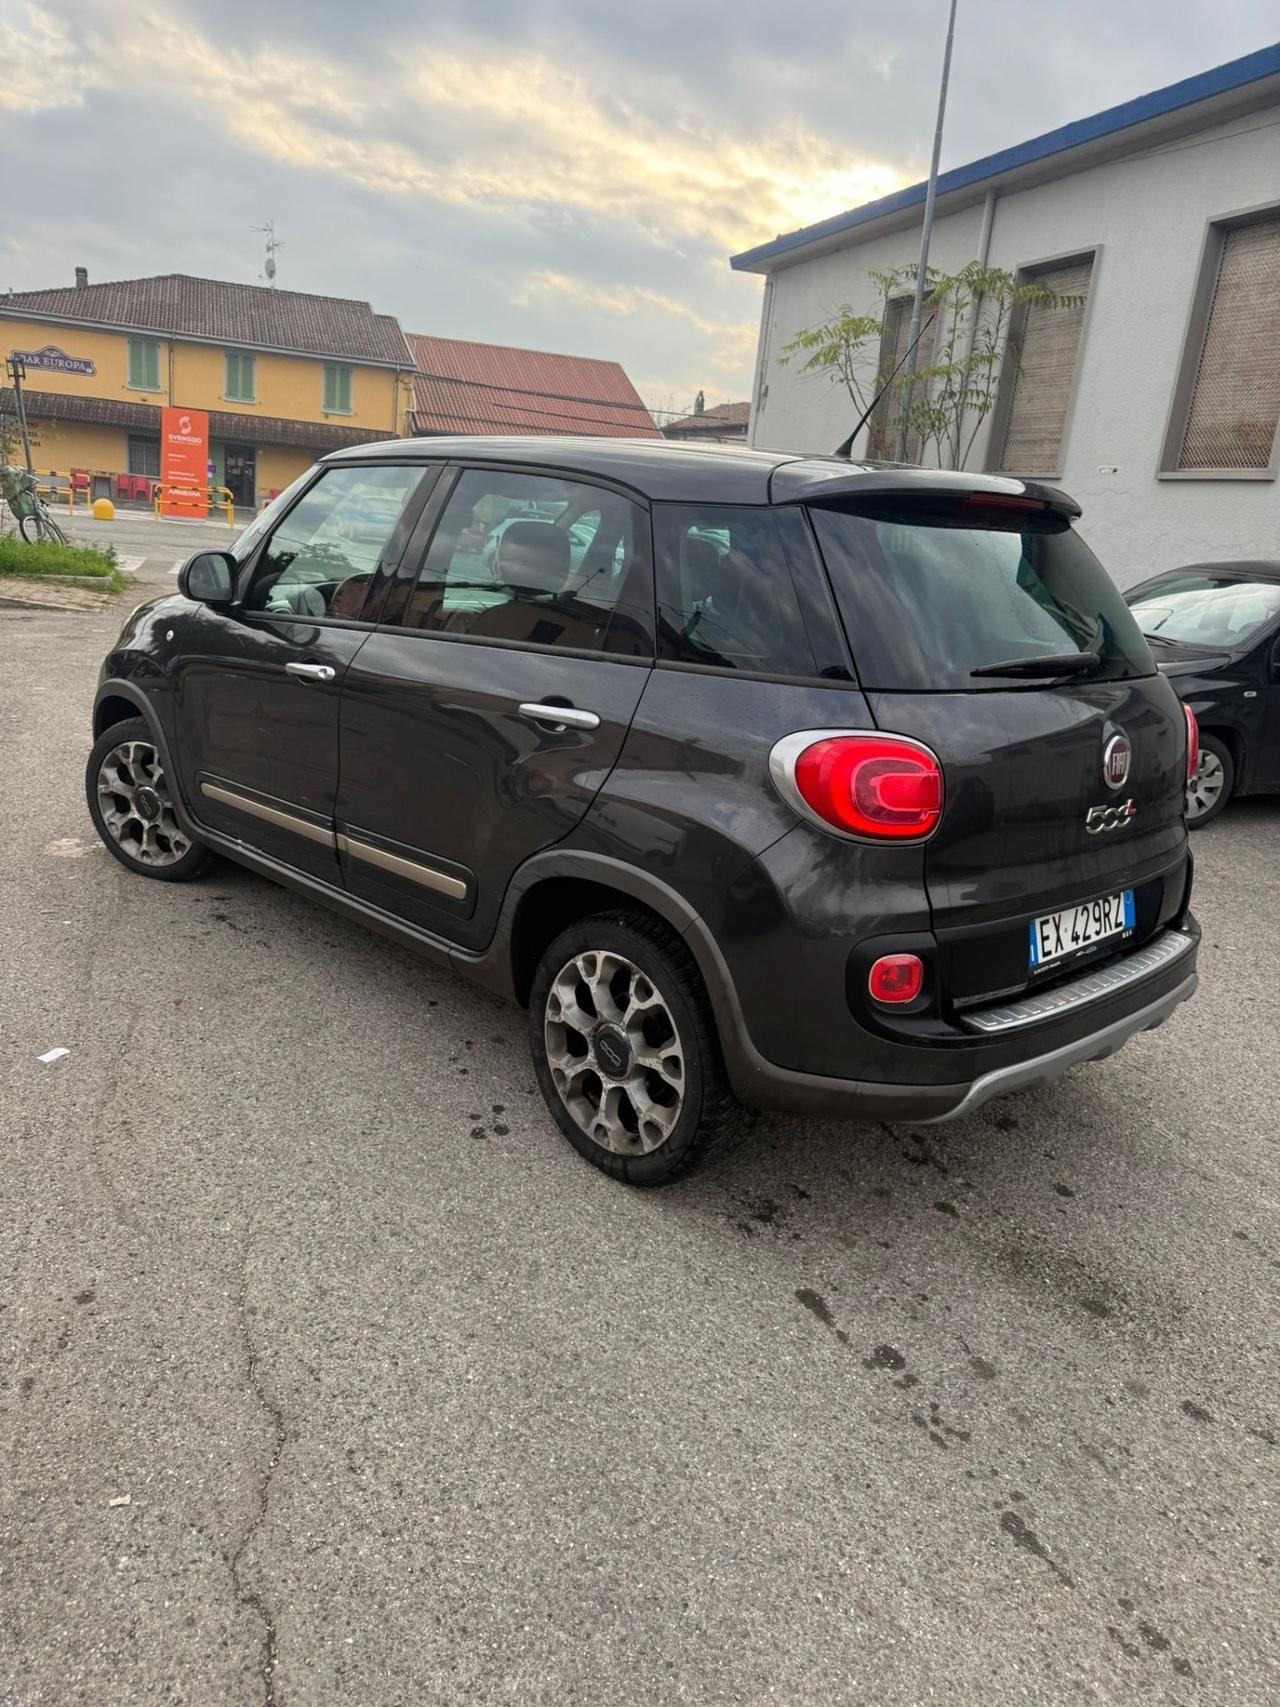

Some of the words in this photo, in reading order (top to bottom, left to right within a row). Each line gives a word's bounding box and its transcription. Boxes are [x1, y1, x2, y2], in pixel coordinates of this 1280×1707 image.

[43, 357, 86, 370] EUROPA
[1111, 751, 1127, 776] FIAT
[1040, 914, 1064, 958] EX
[1071, 896, 1123, 946] 429RZ
